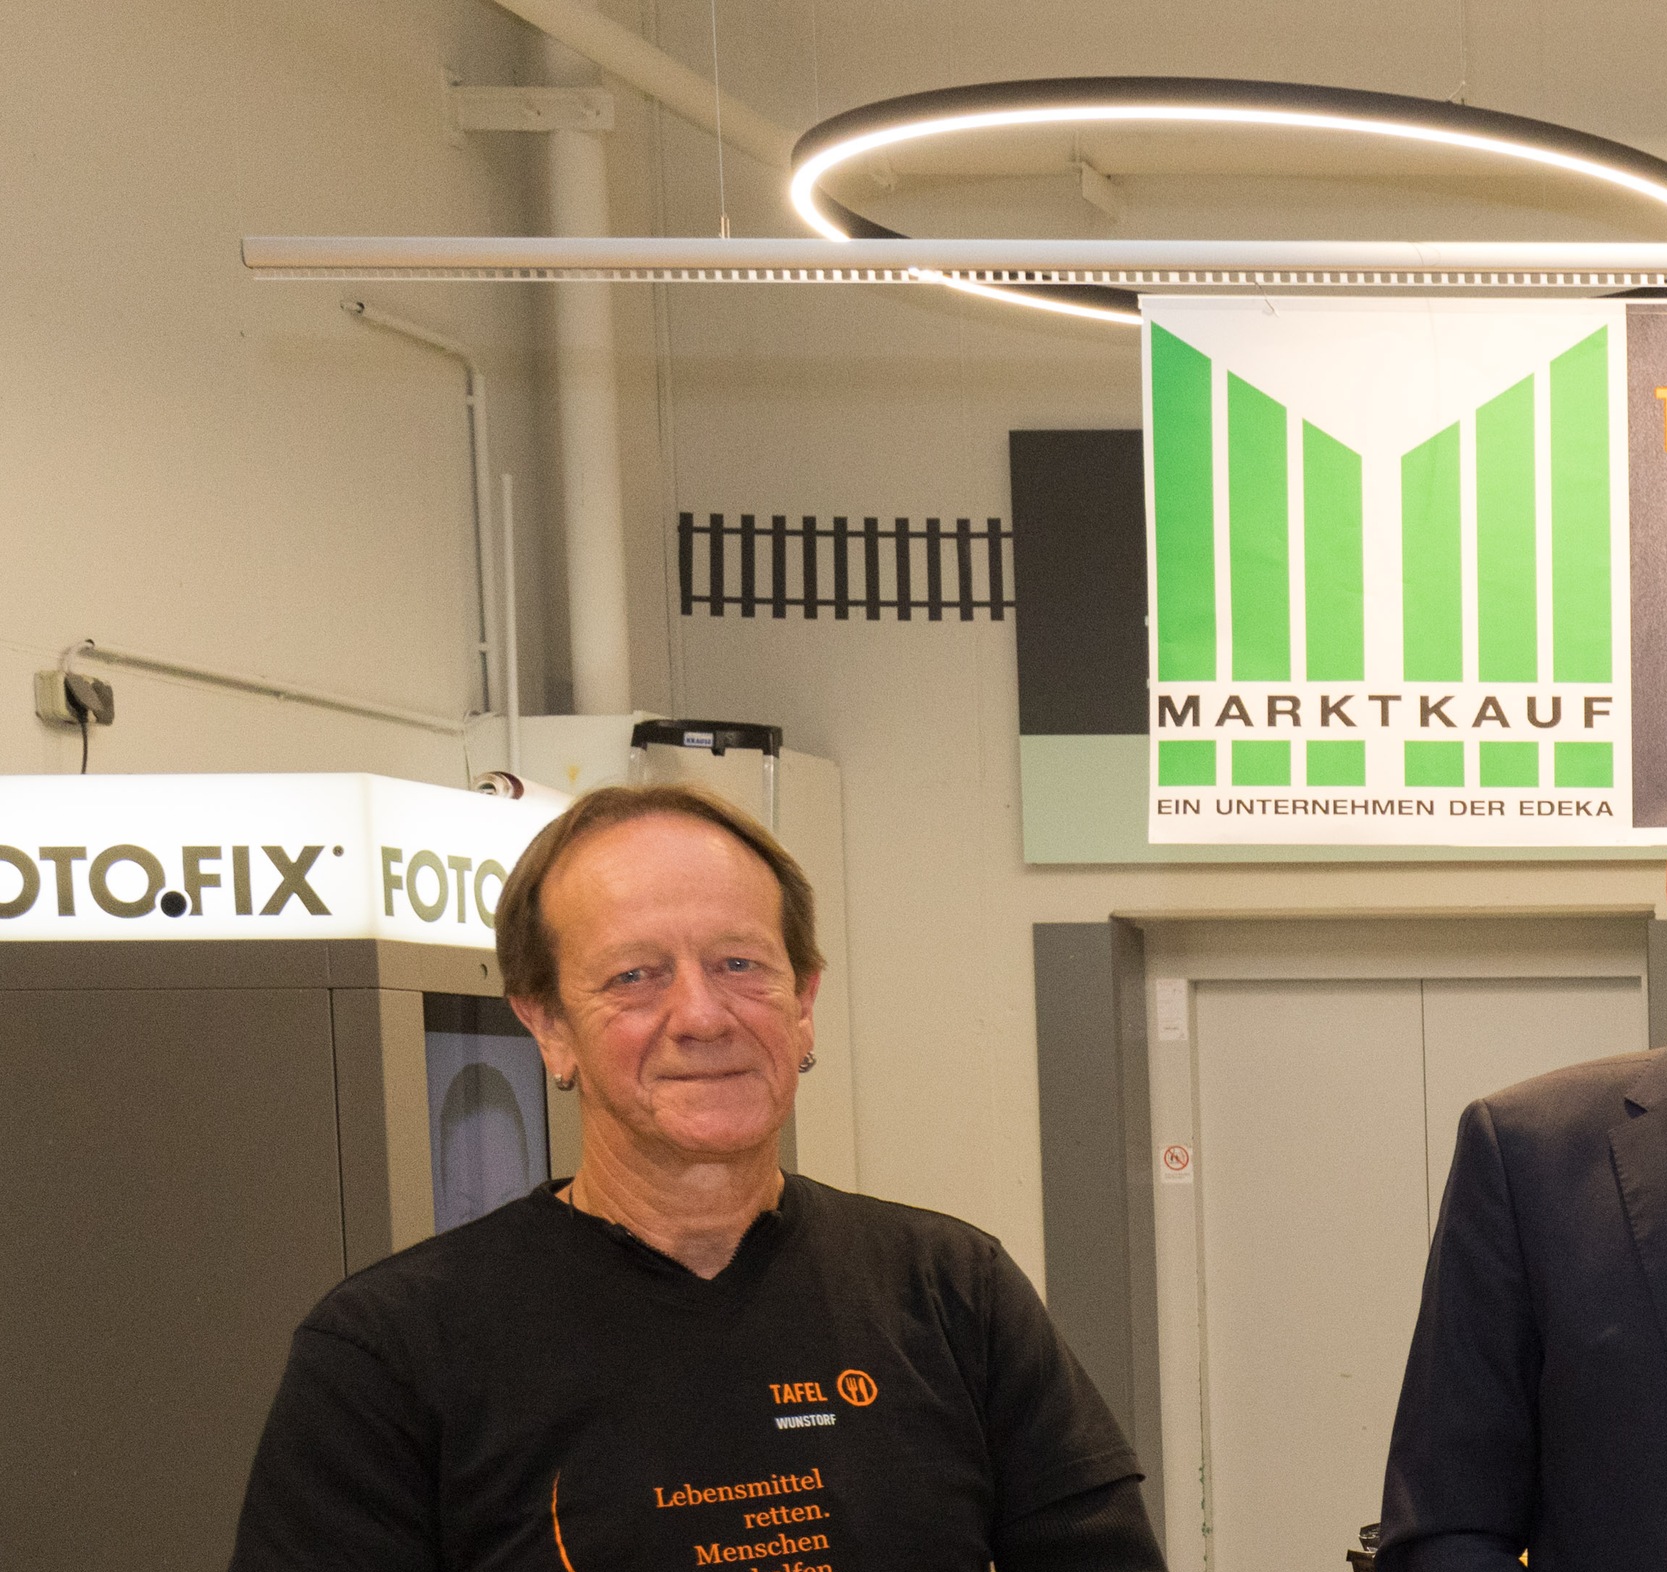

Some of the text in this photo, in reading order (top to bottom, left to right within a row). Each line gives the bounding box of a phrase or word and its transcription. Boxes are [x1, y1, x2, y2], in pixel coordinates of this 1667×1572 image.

[1158, 695, 1612, 728] MARKTKAUF
[1157, 799, 1613, 816] EIN UNTERNEHMEN DER EDEKA
[770, 1382, 828, 1404] TAFEL
[775, 1413, 837, 1430] WUNSTORF
[654, 1468, 825, 1508] Lebensmittel
[743, 1505, 831, 1529] retten.
[694, 1533, 830, 1566] Menschen
